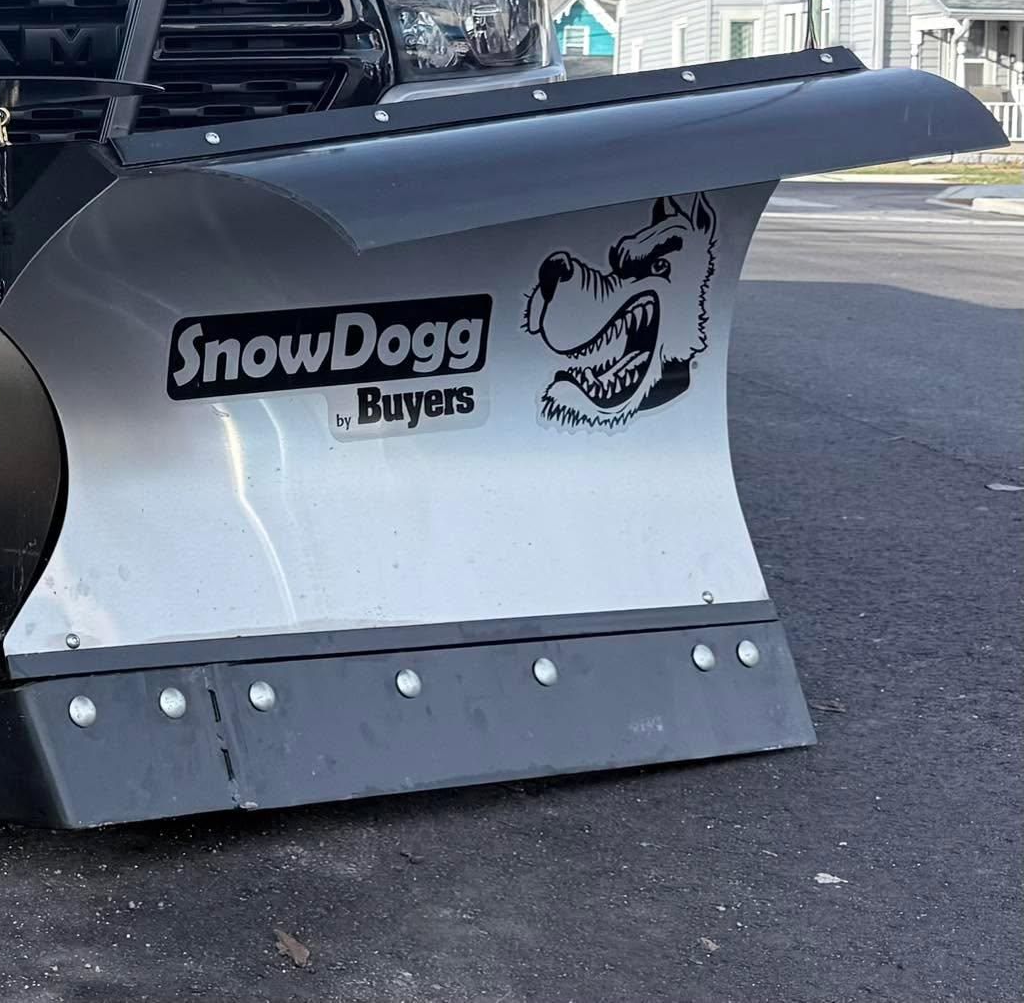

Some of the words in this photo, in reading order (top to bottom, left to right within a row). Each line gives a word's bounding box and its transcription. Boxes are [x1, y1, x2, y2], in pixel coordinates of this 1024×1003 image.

[173, 312, 484, 387] SnowDogg
[336, 414, 352, 430] by
[357, 387, 475, 429] Buyers
